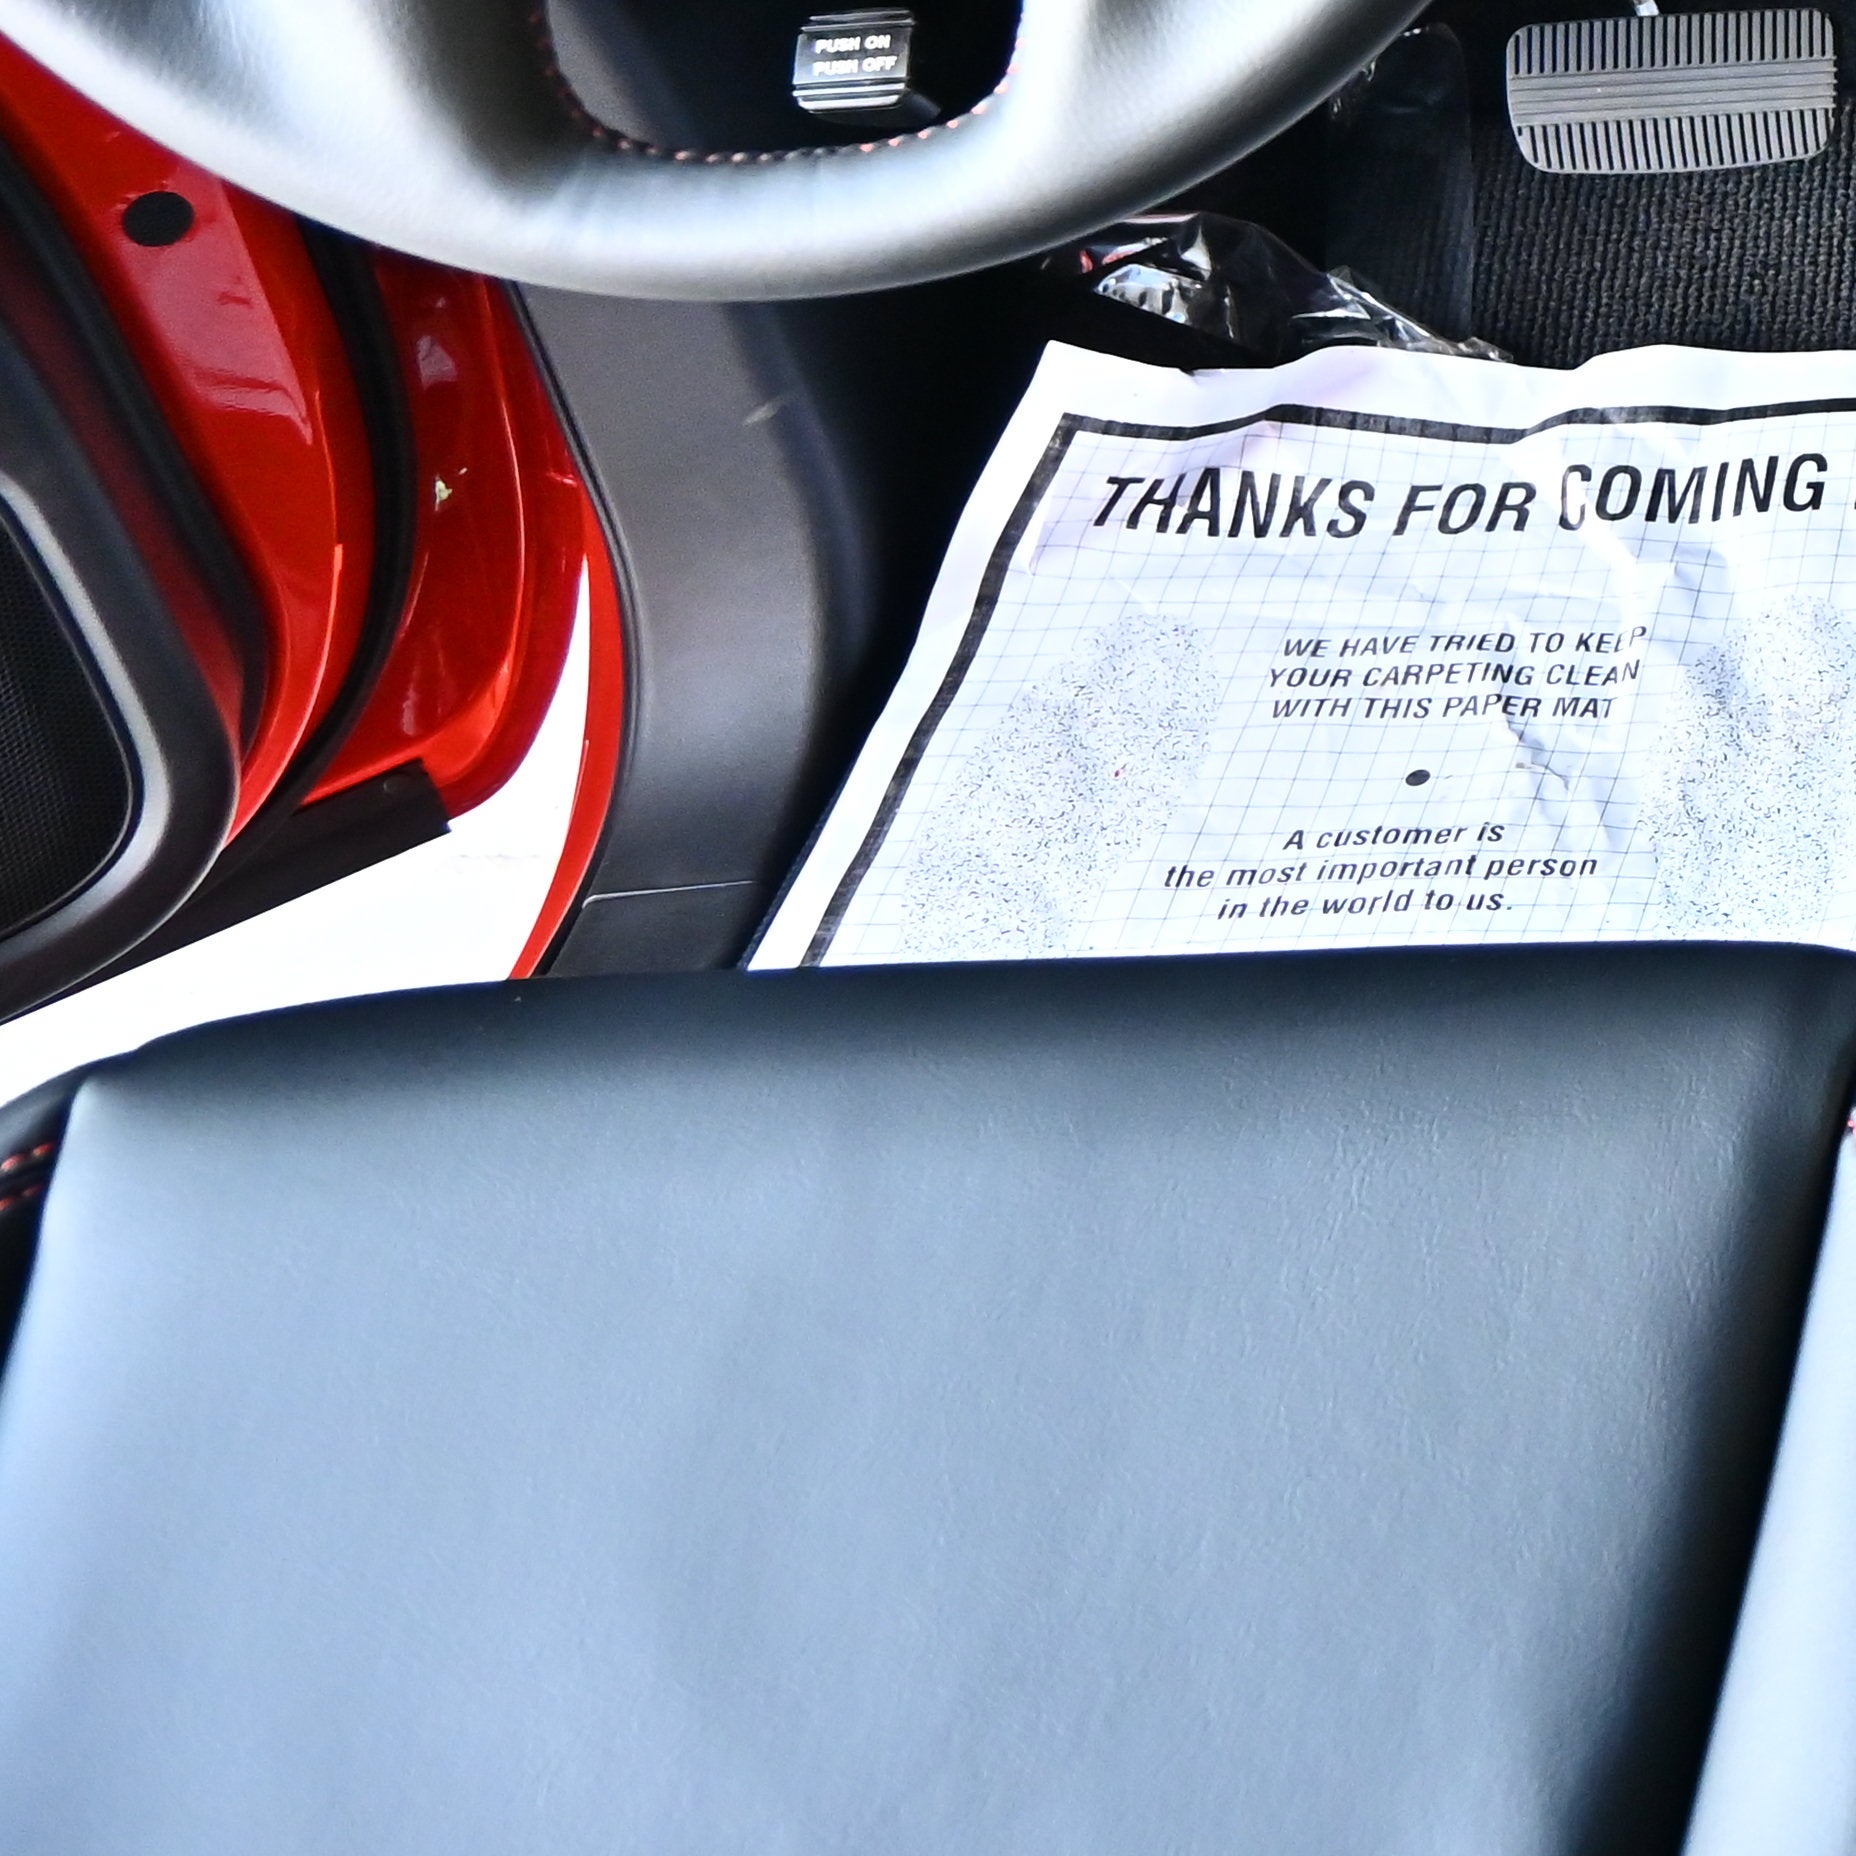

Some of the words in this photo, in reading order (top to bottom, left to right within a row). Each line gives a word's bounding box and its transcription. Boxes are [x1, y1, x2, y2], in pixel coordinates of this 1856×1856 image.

[814, 37, 860, 54] PUSH
[864, 34, 891, 51] ON
[812, 59, 860, 77] PUSH
[862, 55, 898, 73] OFF
[1093, 467, 1376, 539] THANKS
[1391, 481, 1537, 535] FOR
[1558, 451, 1828, 532] COMING
[1283, 638, 1331, 657] WE
[1339, 634, 1419, 657] HAVE
[1429, 632, 1516, 653] TRIED
[1529, 631, 1565, 653] TO
[1575, 625, 1648, 654] KEEP
[1268, 667, 1353, 689] YOUR
[1362, 662, 1535, 688] CARPETING
[1546, 658, 1641, 687] CLEAN
[1271, 697, 1352, 719] WITH
[1363, 697, 1433, 720] THIS
[1442, 693, 1542, 719] PAPER
[1552, 696, 1618, 719] MAT
[1315, 825, 1468, 849] customer
[1476, 822, 1506, 843] is
[1165, 865, 1215, 888] the
[1226, 862, 1309, 887] most
[1317, 854, 1477, 885] important
[1484, 857, 1598, 881] person
[1217, 899, 1249, 920] in
[1259, 896, 1310, 919] the
[1321, 889, 1414, 915] world
[1424, 891, 1455, 913] to
